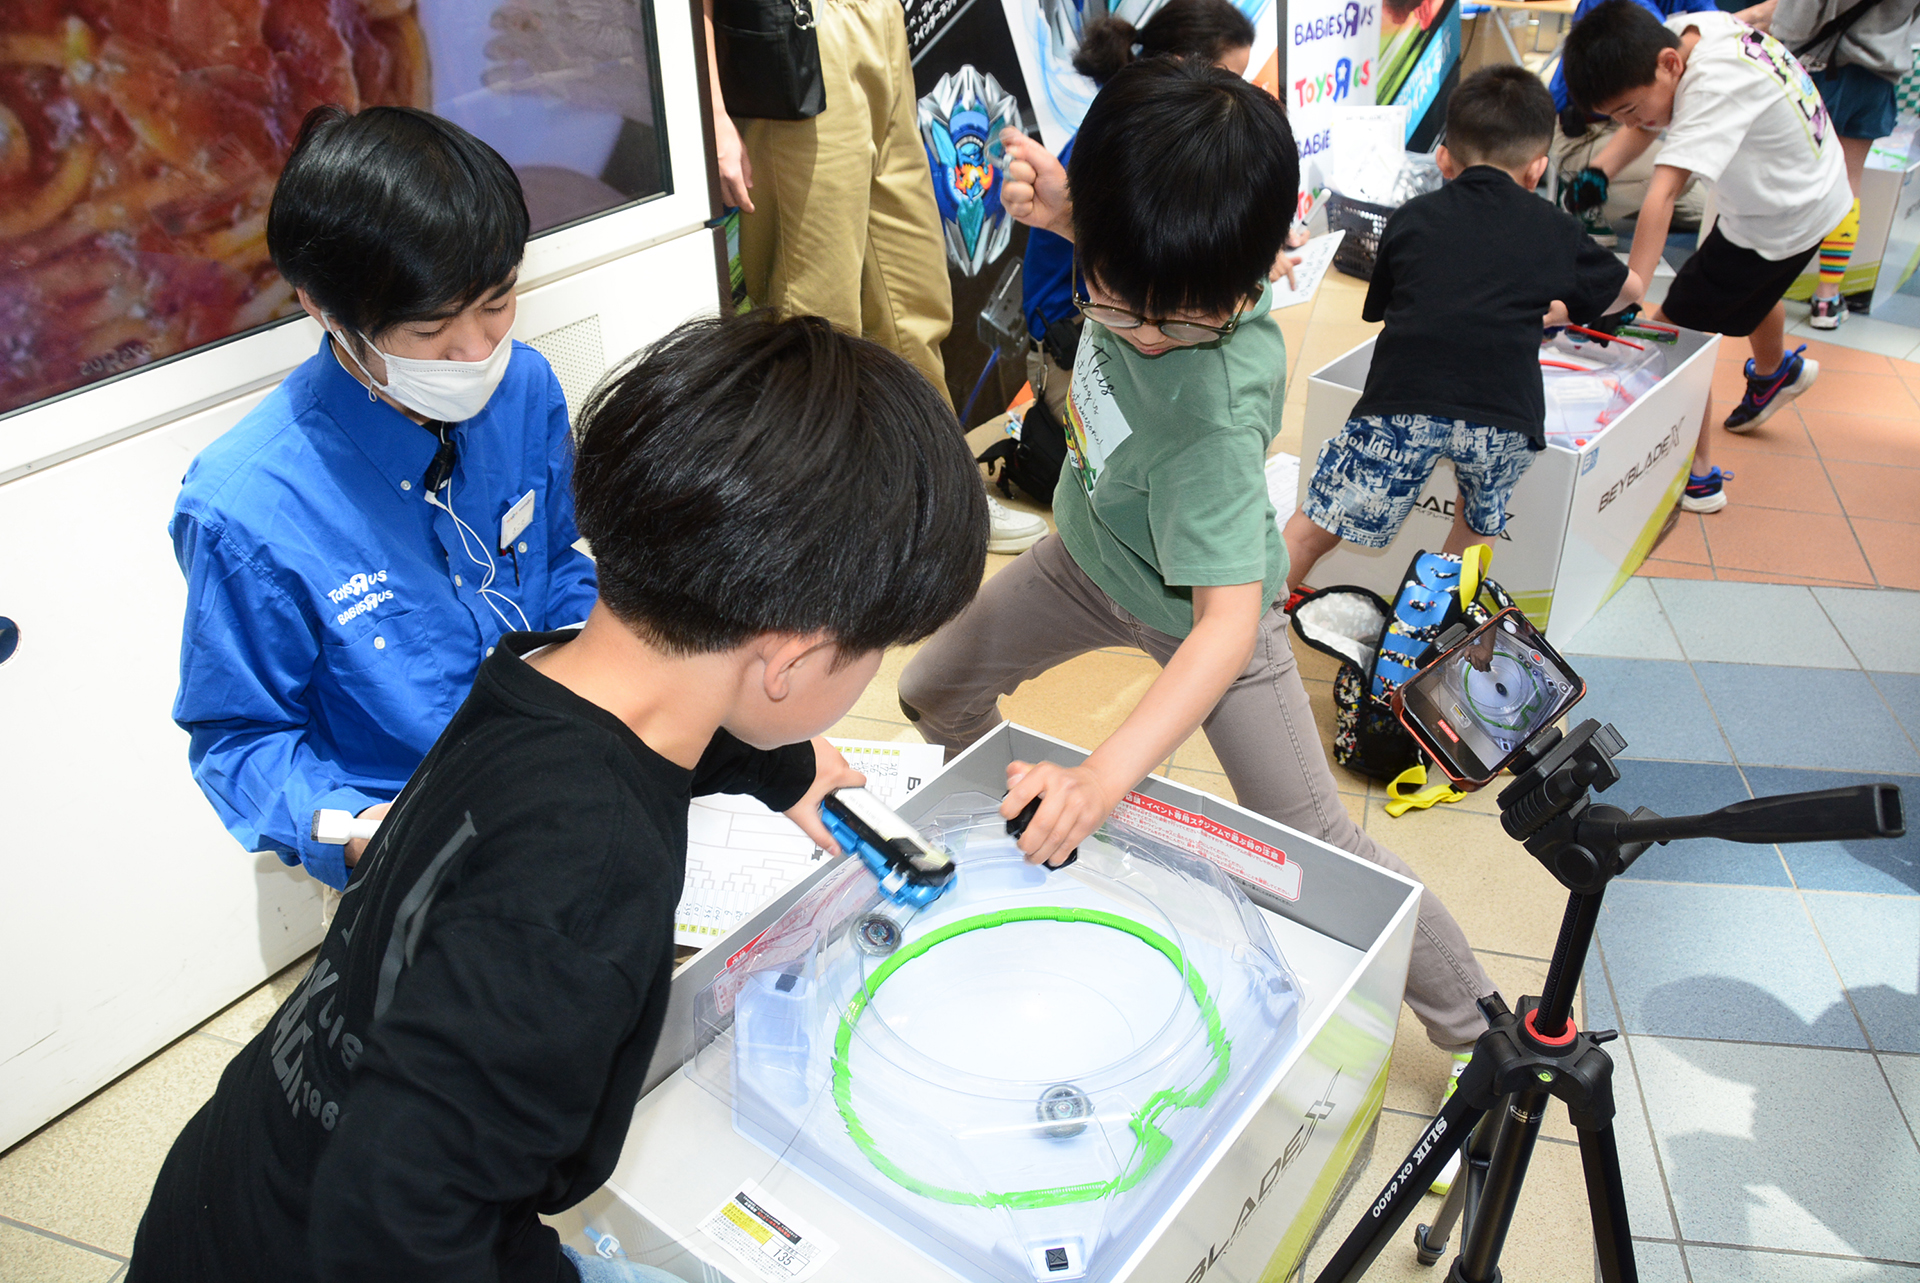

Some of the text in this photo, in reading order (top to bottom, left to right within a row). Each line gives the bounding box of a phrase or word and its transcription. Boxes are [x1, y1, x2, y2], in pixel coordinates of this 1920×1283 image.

[1413, 1116, 1448, 1166] SLIK
[1372, 1183, 1398, 1218] 6400
[773, 1248, 795, 1266] 135
